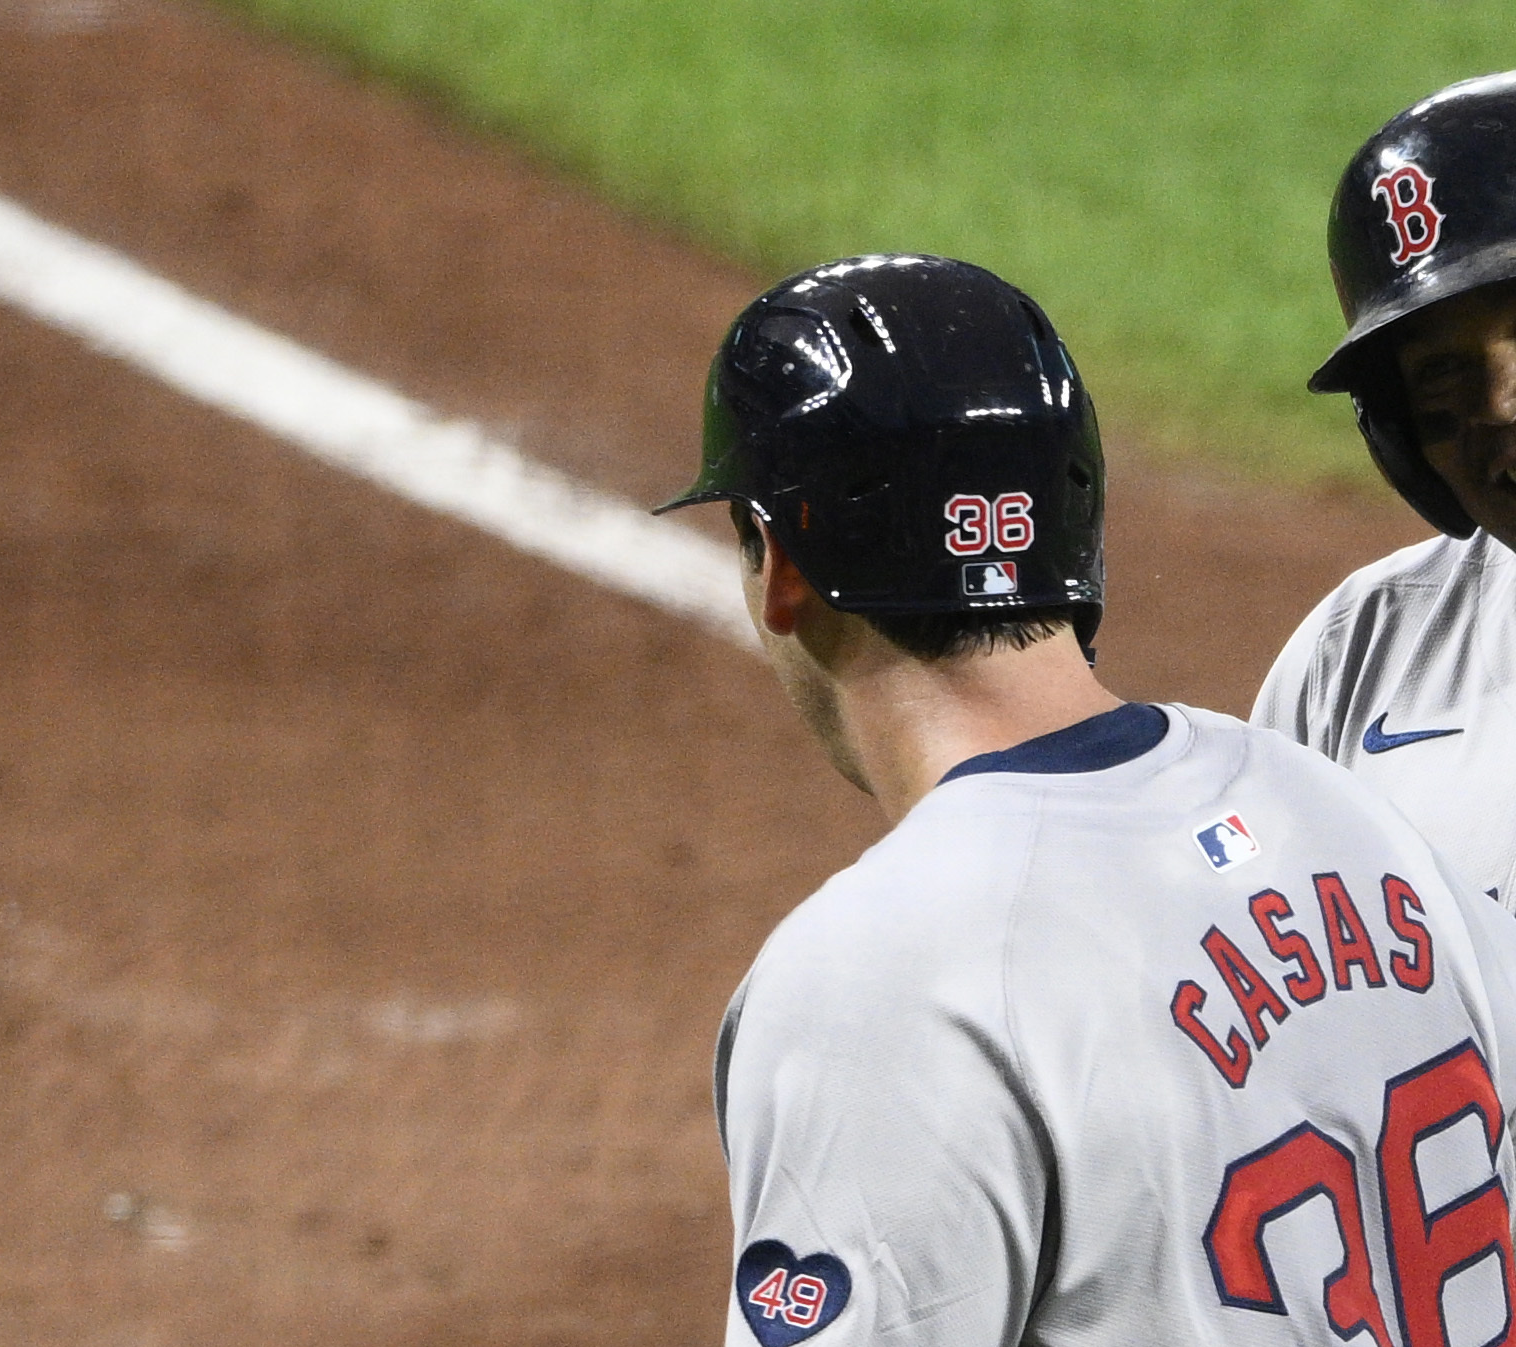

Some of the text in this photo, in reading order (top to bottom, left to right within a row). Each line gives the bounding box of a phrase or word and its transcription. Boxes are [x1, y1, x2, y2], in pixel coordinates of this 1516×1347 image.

[1372, 162, 1447, 266] B
[945, 492, 1035, 557] 36
[1170, 871, 1435, 1089] CASAS
[748, 1267, 827, 1329] 49
